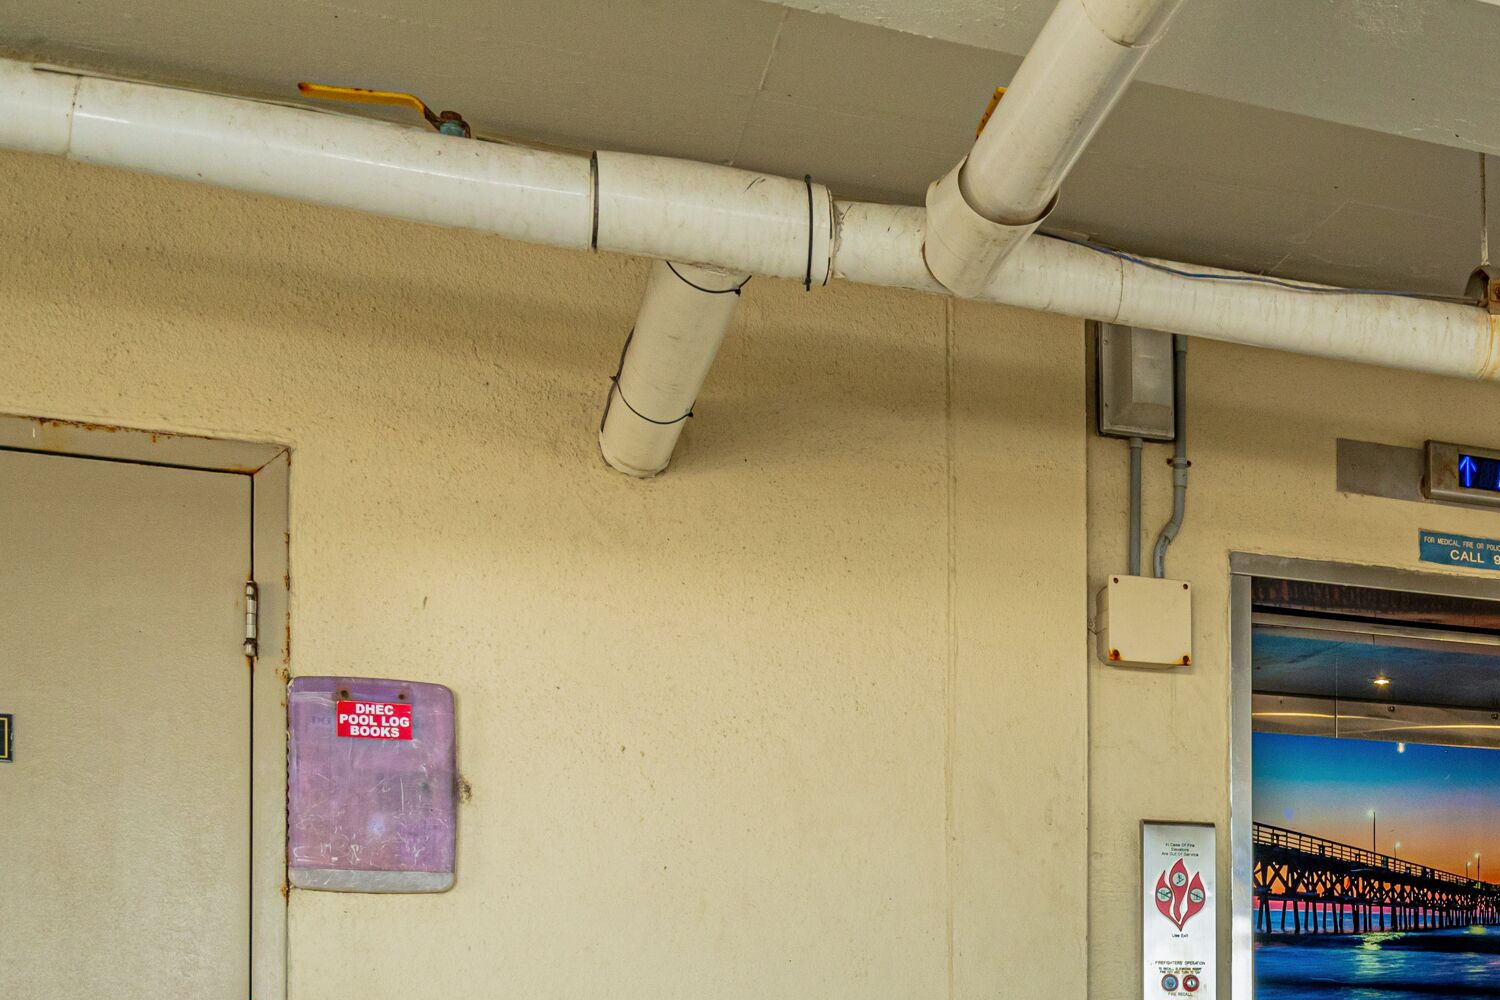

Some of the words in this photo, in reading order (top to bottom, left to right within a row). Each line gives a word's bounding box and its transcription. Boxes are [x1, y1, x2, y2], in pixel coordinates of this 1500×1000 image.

[1424, 536, 1434, 544] FOR
[1450, 550, 1484, 564] CALL
[355, 704, 394, 715] DHEC
[340, 714, 377, 726] POOL
[382, 716, 410, 727] LOG
[350, 726, 399, 737] BOOKS
